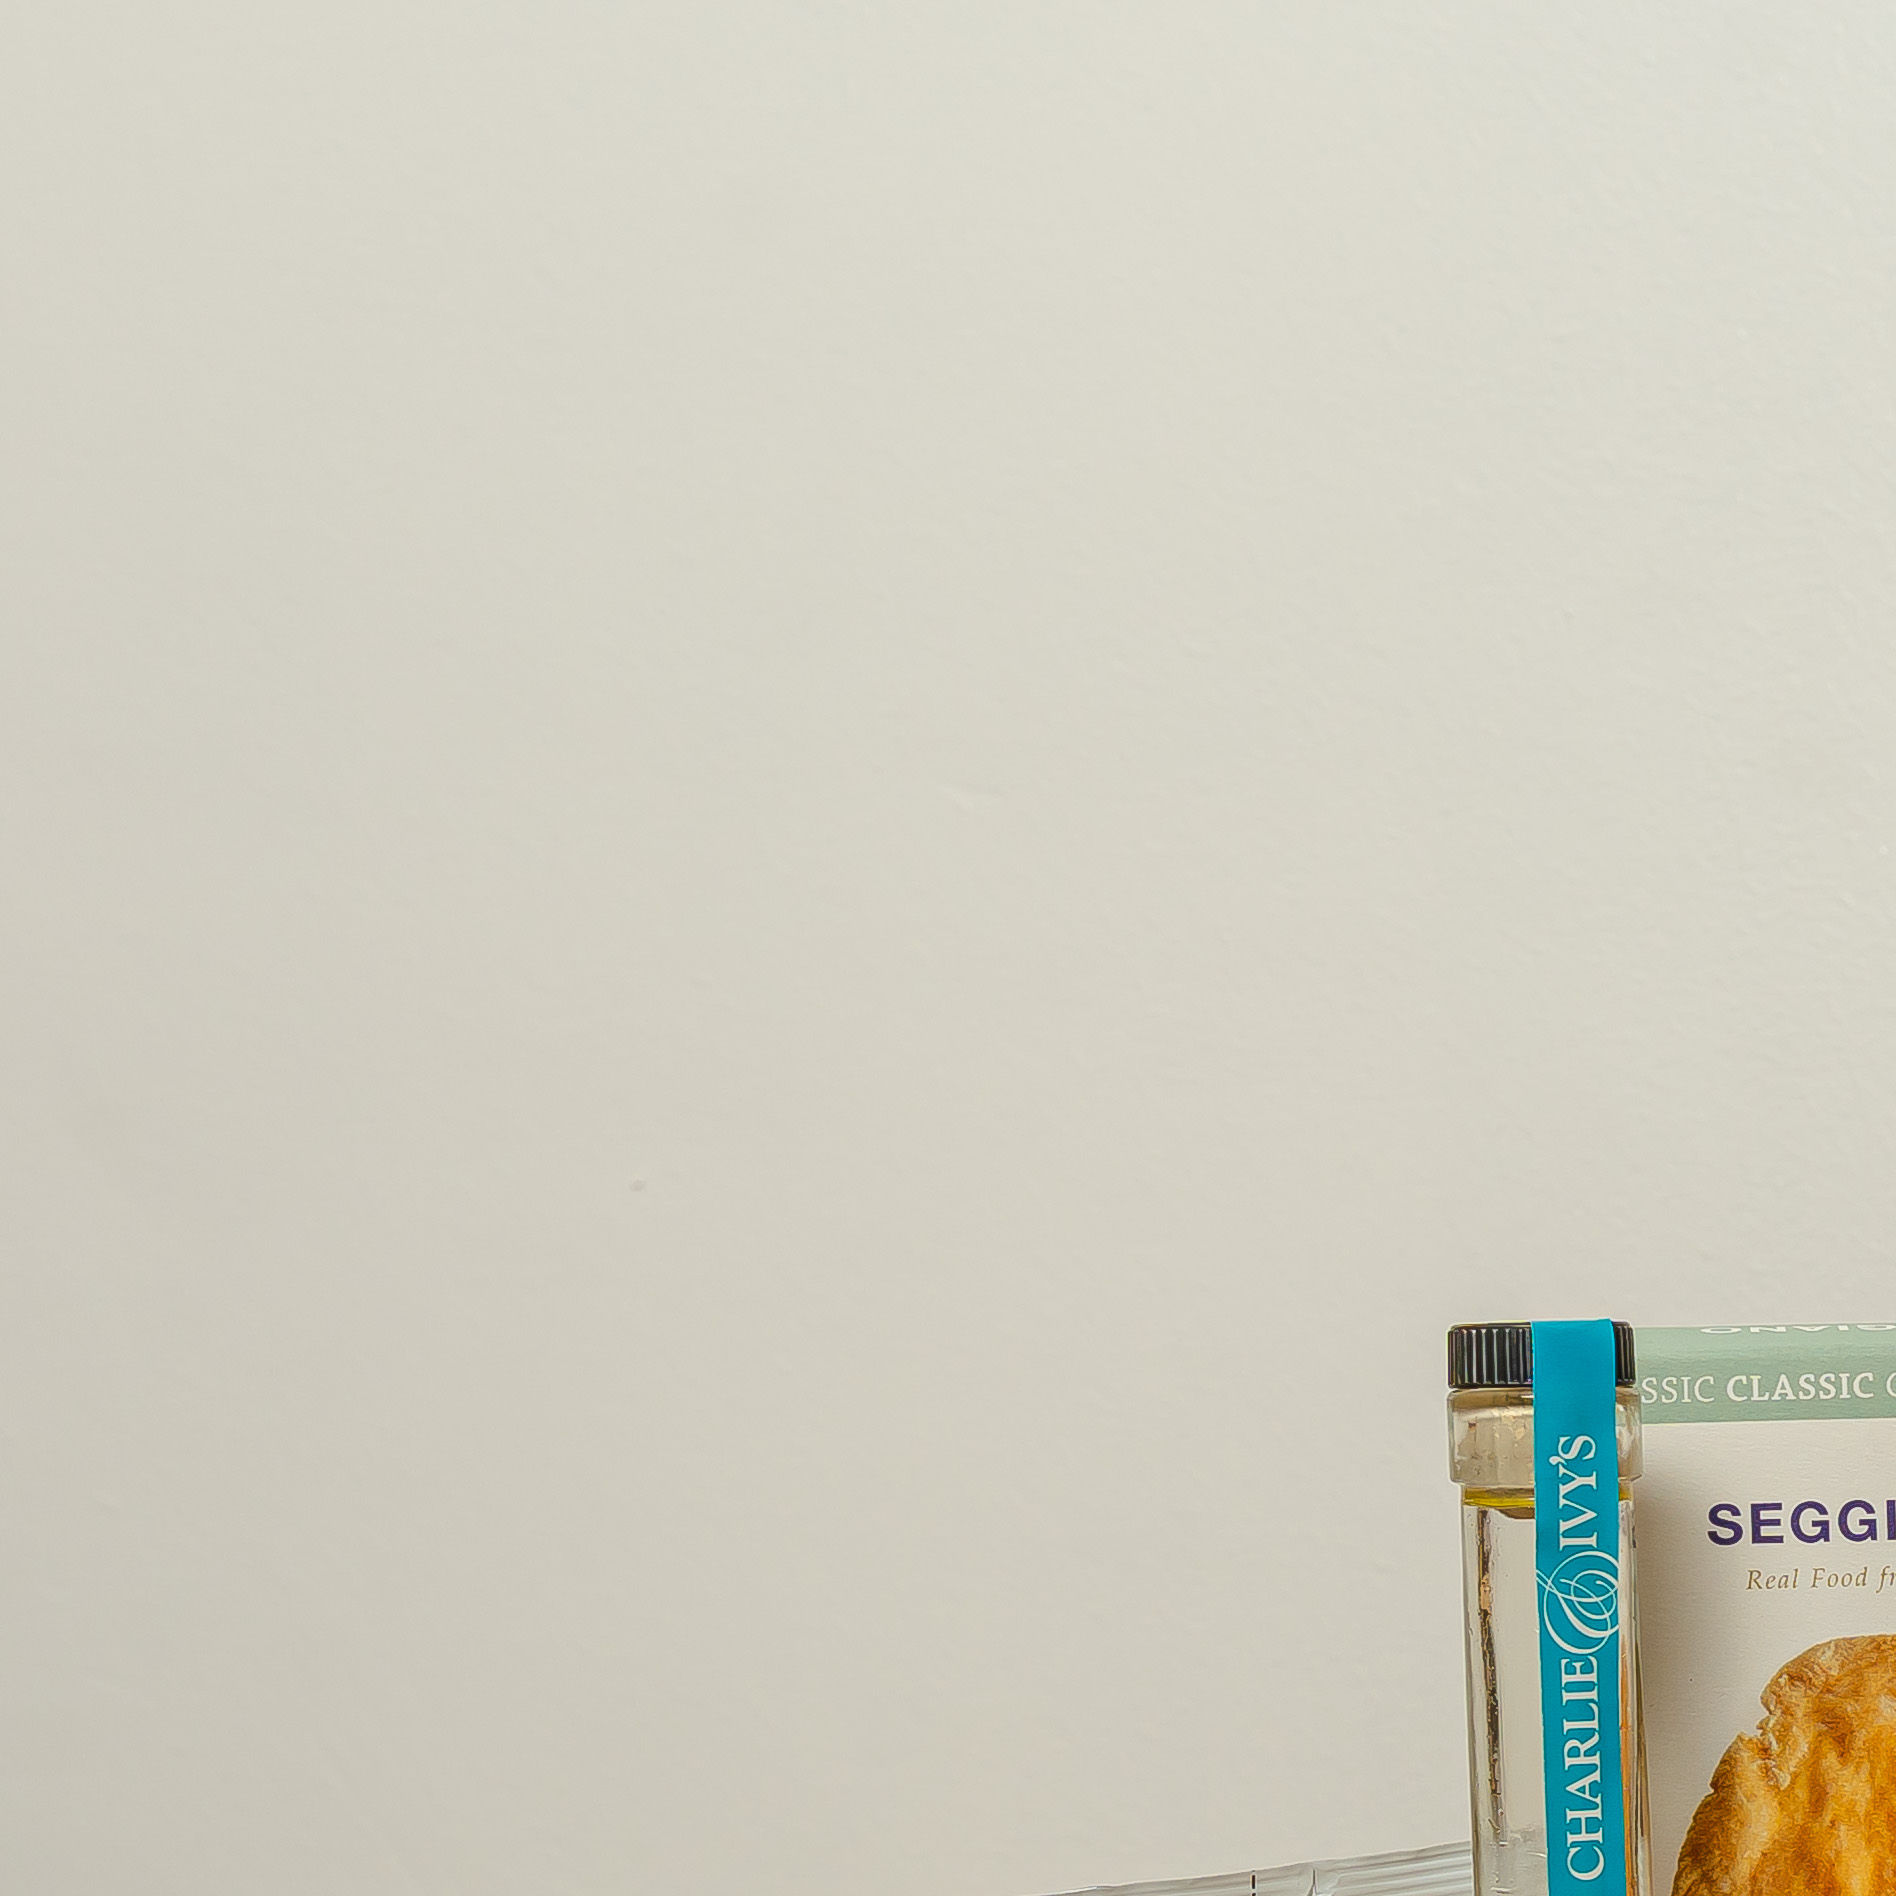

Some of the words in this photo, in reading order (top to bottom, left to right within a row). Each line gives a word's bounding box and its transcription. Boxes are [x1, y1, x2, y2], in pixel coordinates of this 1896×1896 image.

[1727, 1372, 1873, 1402] CLASSIC
[1548, 1434, 1597, 1550] IVY'S
[1746, 1567, 1798, 1591] Real
[1810, 1566, 1867, 1588] Food
[1561, 1656, 1605, 1882] CHARLIE
